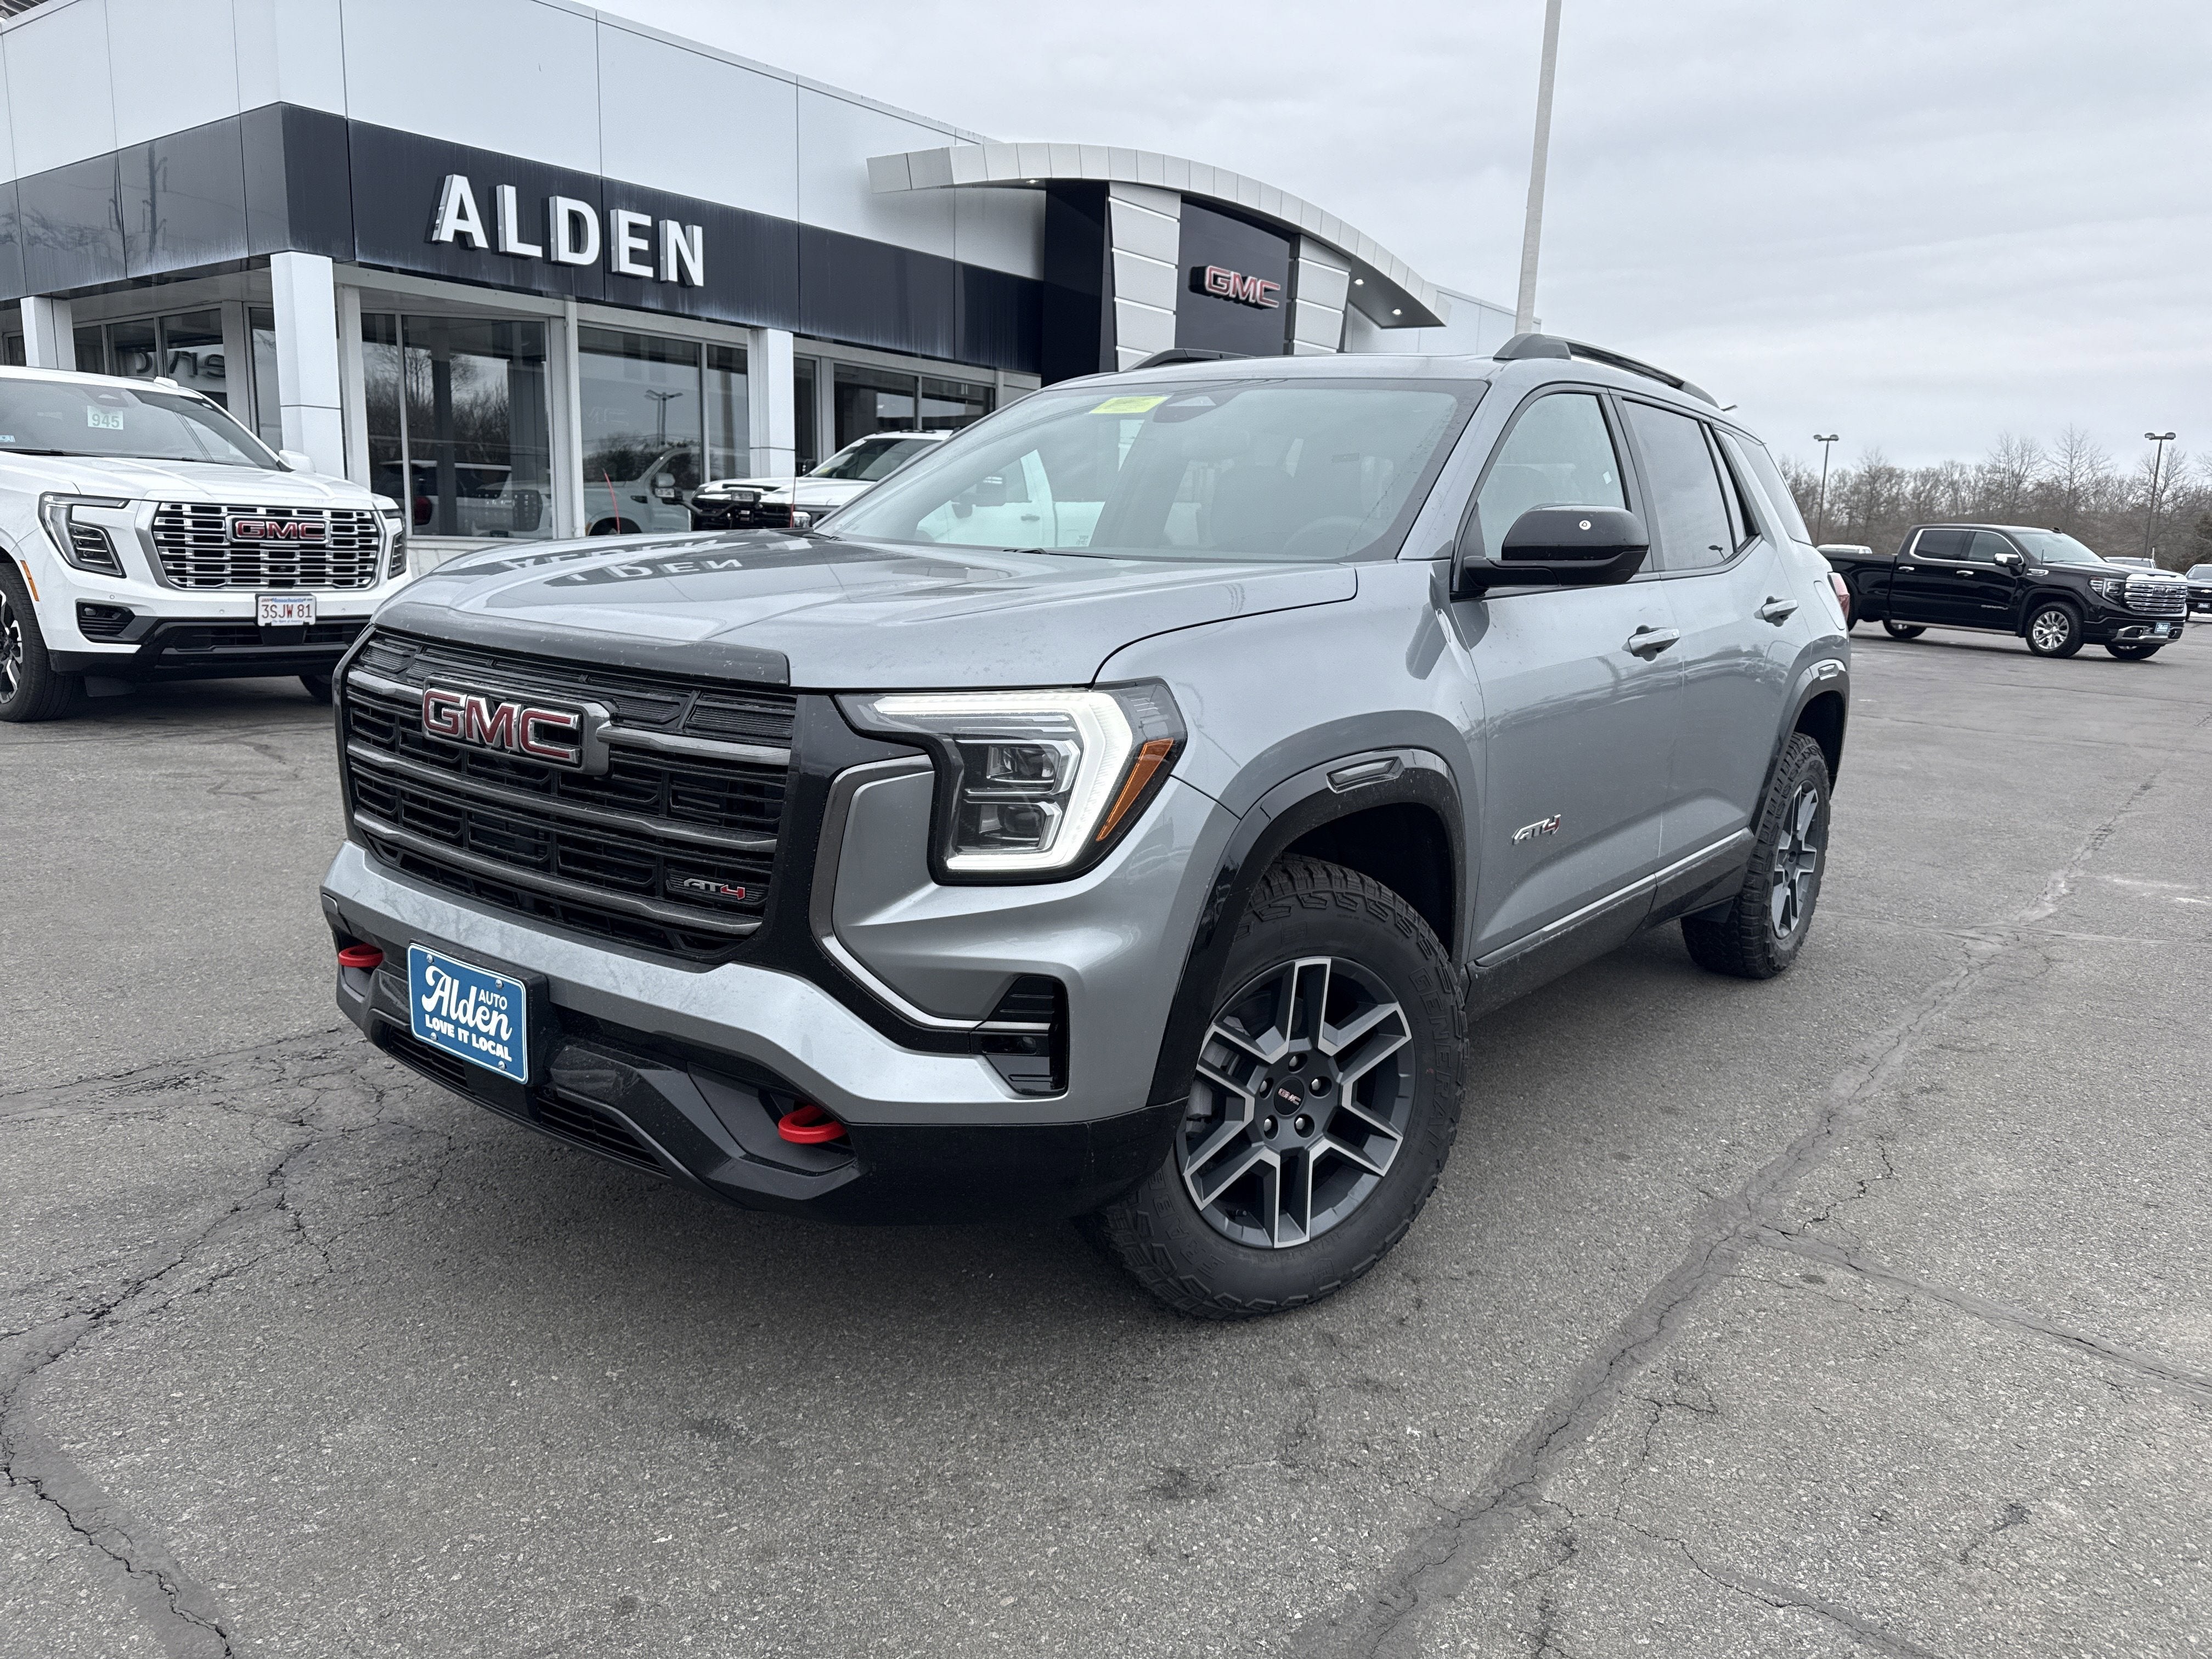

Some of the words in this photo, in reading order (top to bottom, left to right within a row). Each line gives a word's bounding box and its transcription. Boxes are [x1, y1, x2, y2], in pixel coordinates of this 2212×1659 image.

[432, 174, 704, 287] ALDEN
[1205, 265, 1281, 309] GMC
[92, 413, 120, 428] 945
[235, 521, 325, 540] GMC
[261, 603, 294, 619] 3SJW
[297, 603, 312, 618] 81
[422, 687, 579, 764] GMC
[1511, 814, 1561, 845] AT4
[684, 878, 745, 900] AT4
[421, 965, 512, 1041] Alden
[478, 989, 508, 1011] AUTO
[425, 1013, 455, 1039] LOVE
[458, 1027, 470, 1044] IT
[471, 1033, 512, 1062] LOCAL
[1408, 966, 1452, 1155] GENERAL
[1278, 1088, 1301, 1106] GMC
